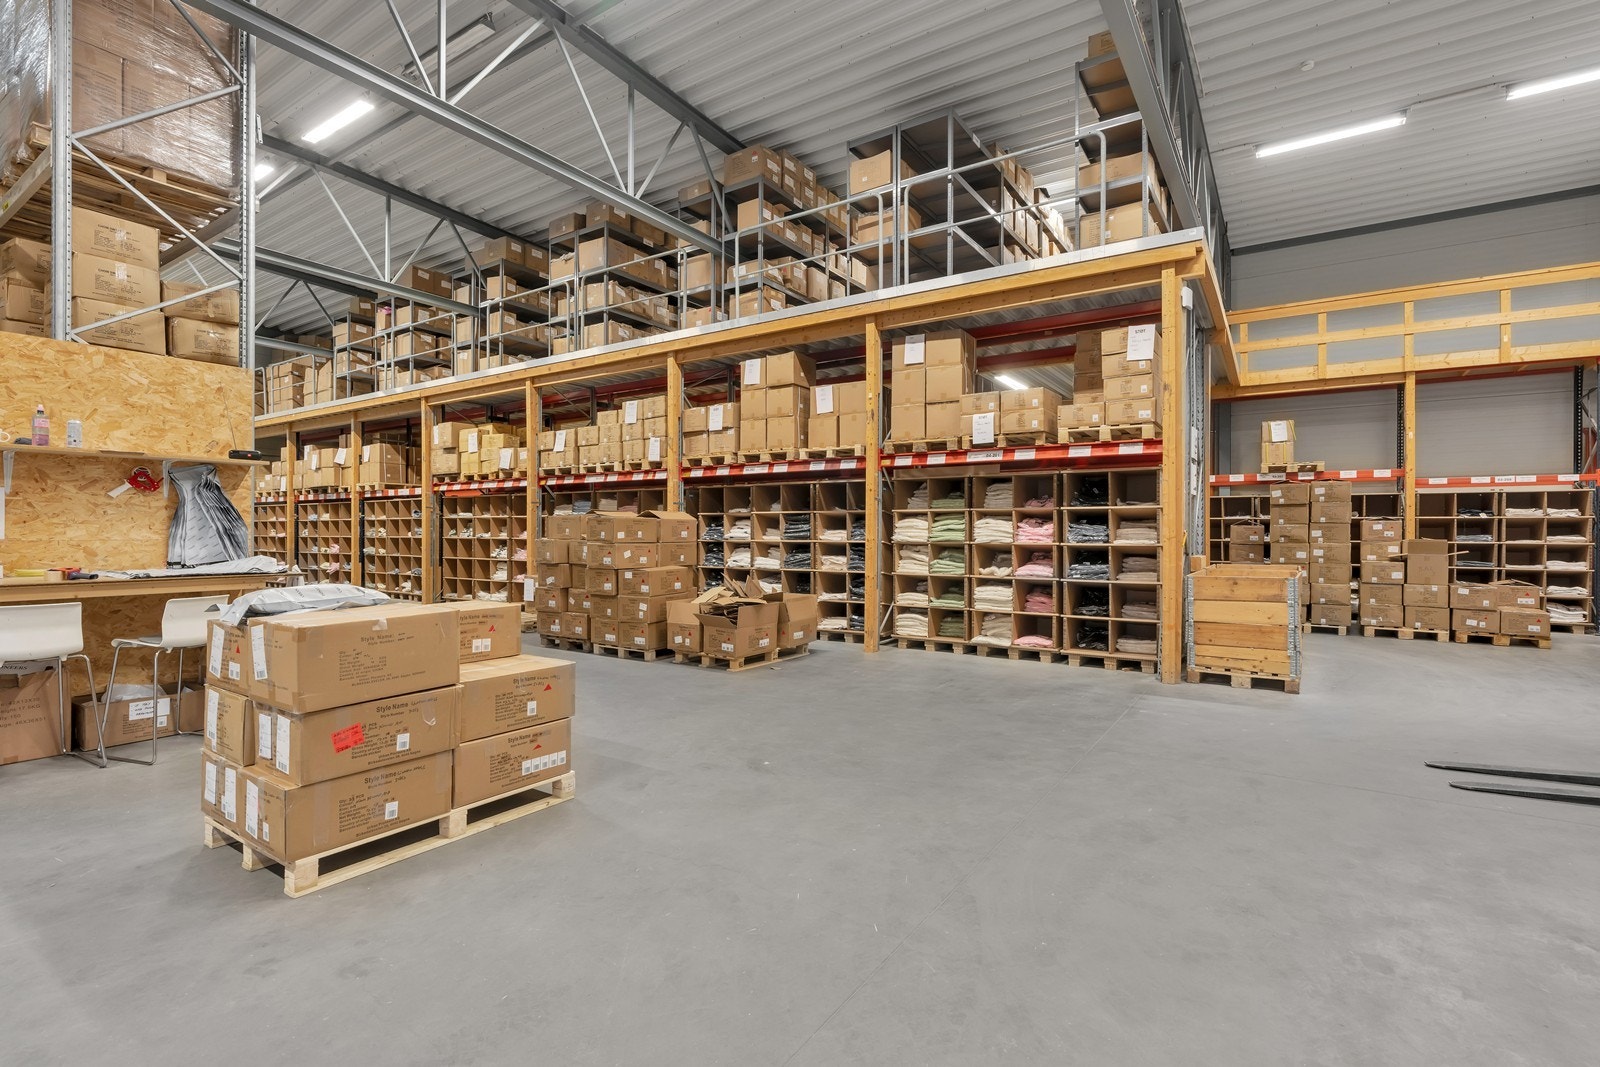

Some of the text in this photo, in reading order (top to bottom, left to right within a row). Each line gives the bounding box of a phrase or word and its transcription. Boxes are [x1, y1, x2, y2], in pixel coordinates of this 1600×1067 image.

[376, 704, 392, 712] Style
[364, 775, 380, 784] Style
[380, 772, 396, 780] Name
